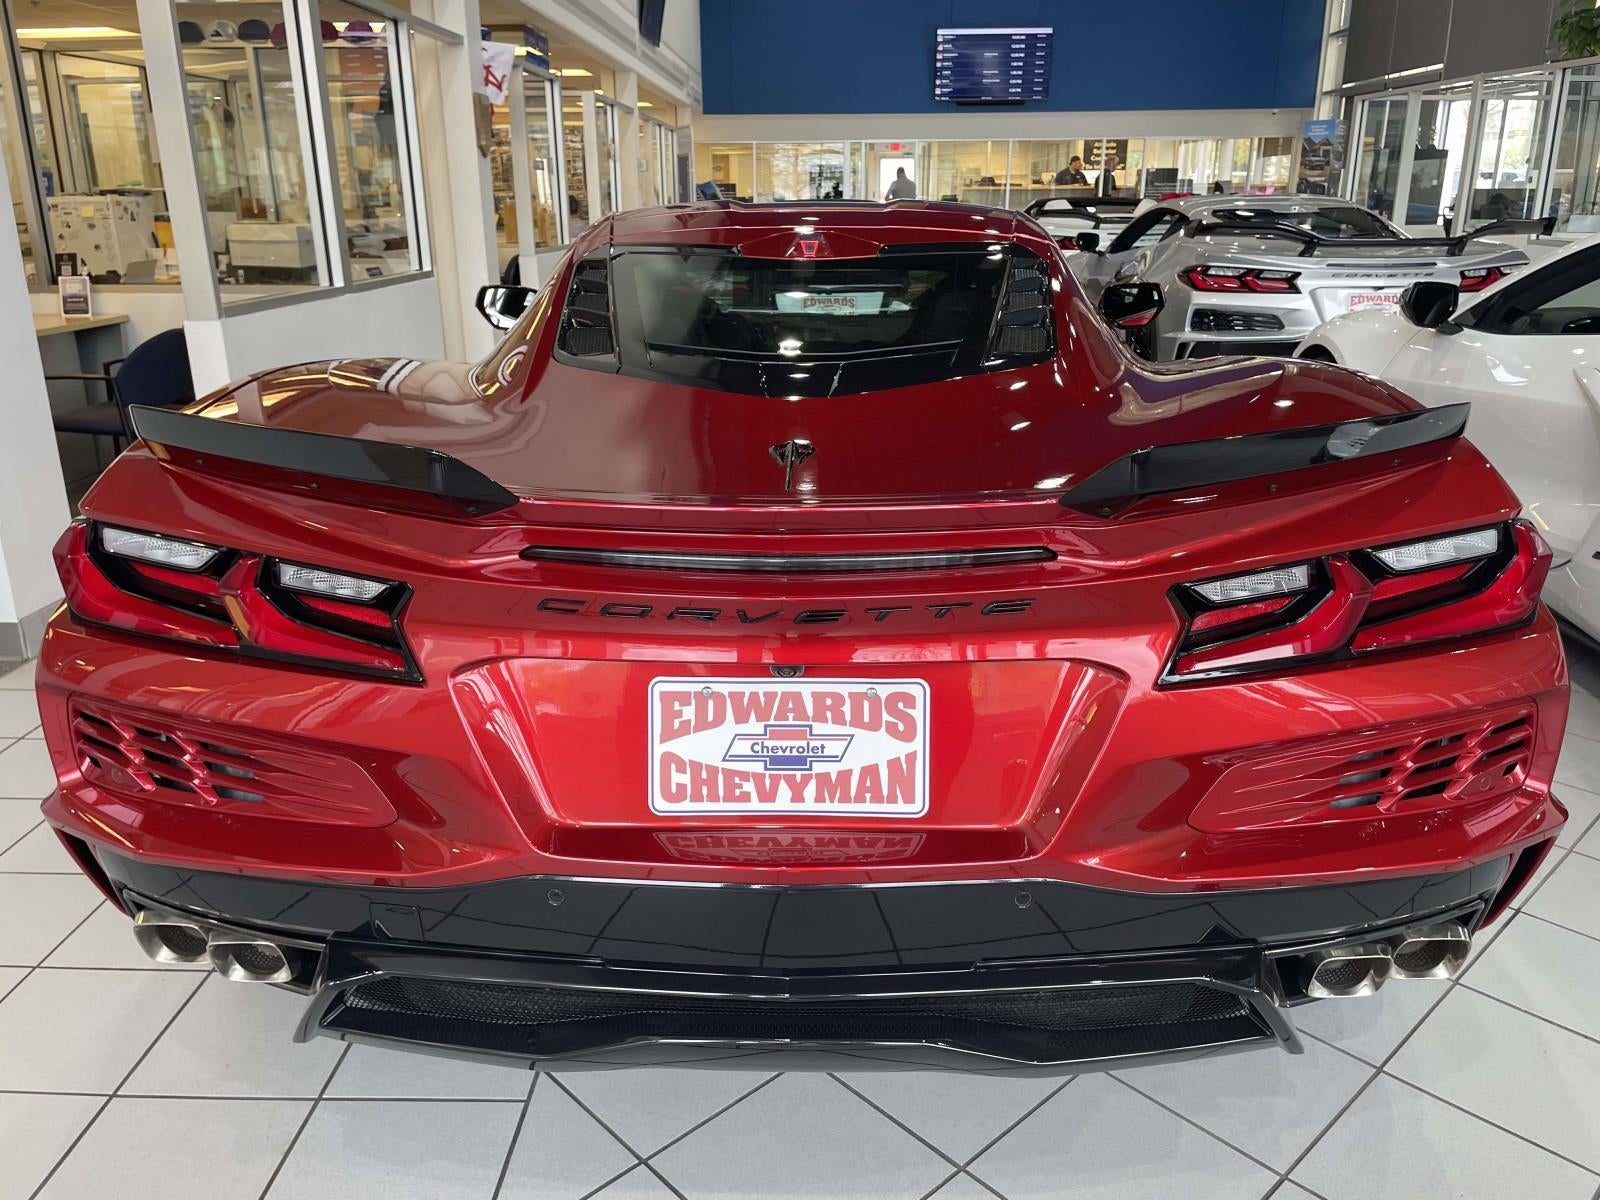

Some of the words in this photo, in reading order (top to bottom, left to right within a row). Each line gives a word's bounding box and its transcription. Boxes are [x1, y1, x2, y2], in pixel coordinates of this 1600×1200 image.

[803, 297, 855, 309] EDWARDS
[1350, 294, 1403, 307] EDWARD
[536, 597, 1037, 625] CORVETTE
[659, 690, 918, 744] EDWARDS
[750, 741, 826, 755] Chevrolet
[659, 750, 918, 805] CHEVYMAN
